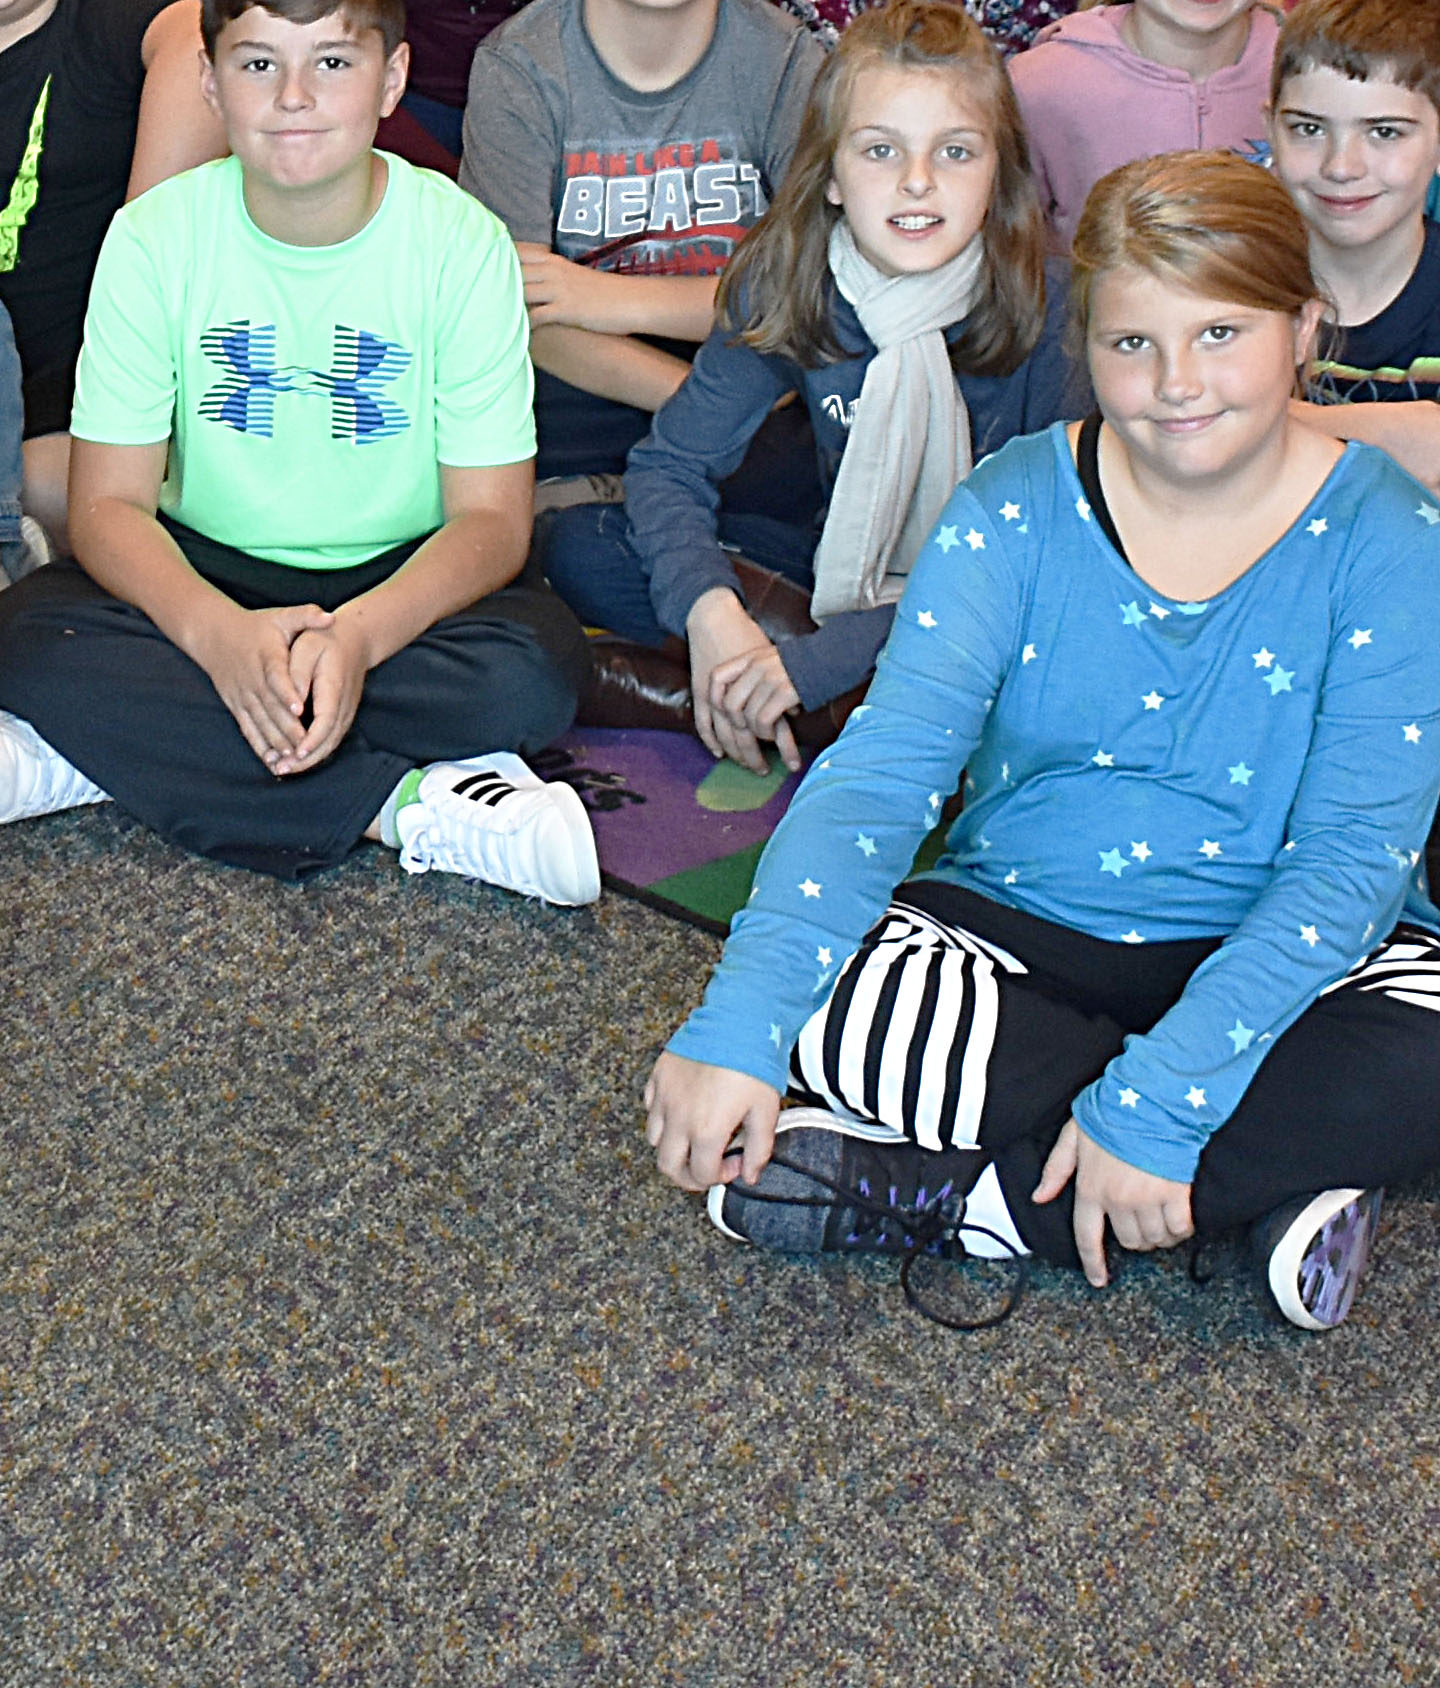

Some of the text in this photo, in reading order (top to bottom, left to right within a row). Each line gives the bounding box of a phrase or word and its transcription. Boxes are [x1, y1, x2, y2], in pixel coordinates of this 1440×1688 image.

[634, 143, 696, 176] LIKE
[700, 138, 722, 164] A
[557, 163, 772, 239] BEAST
